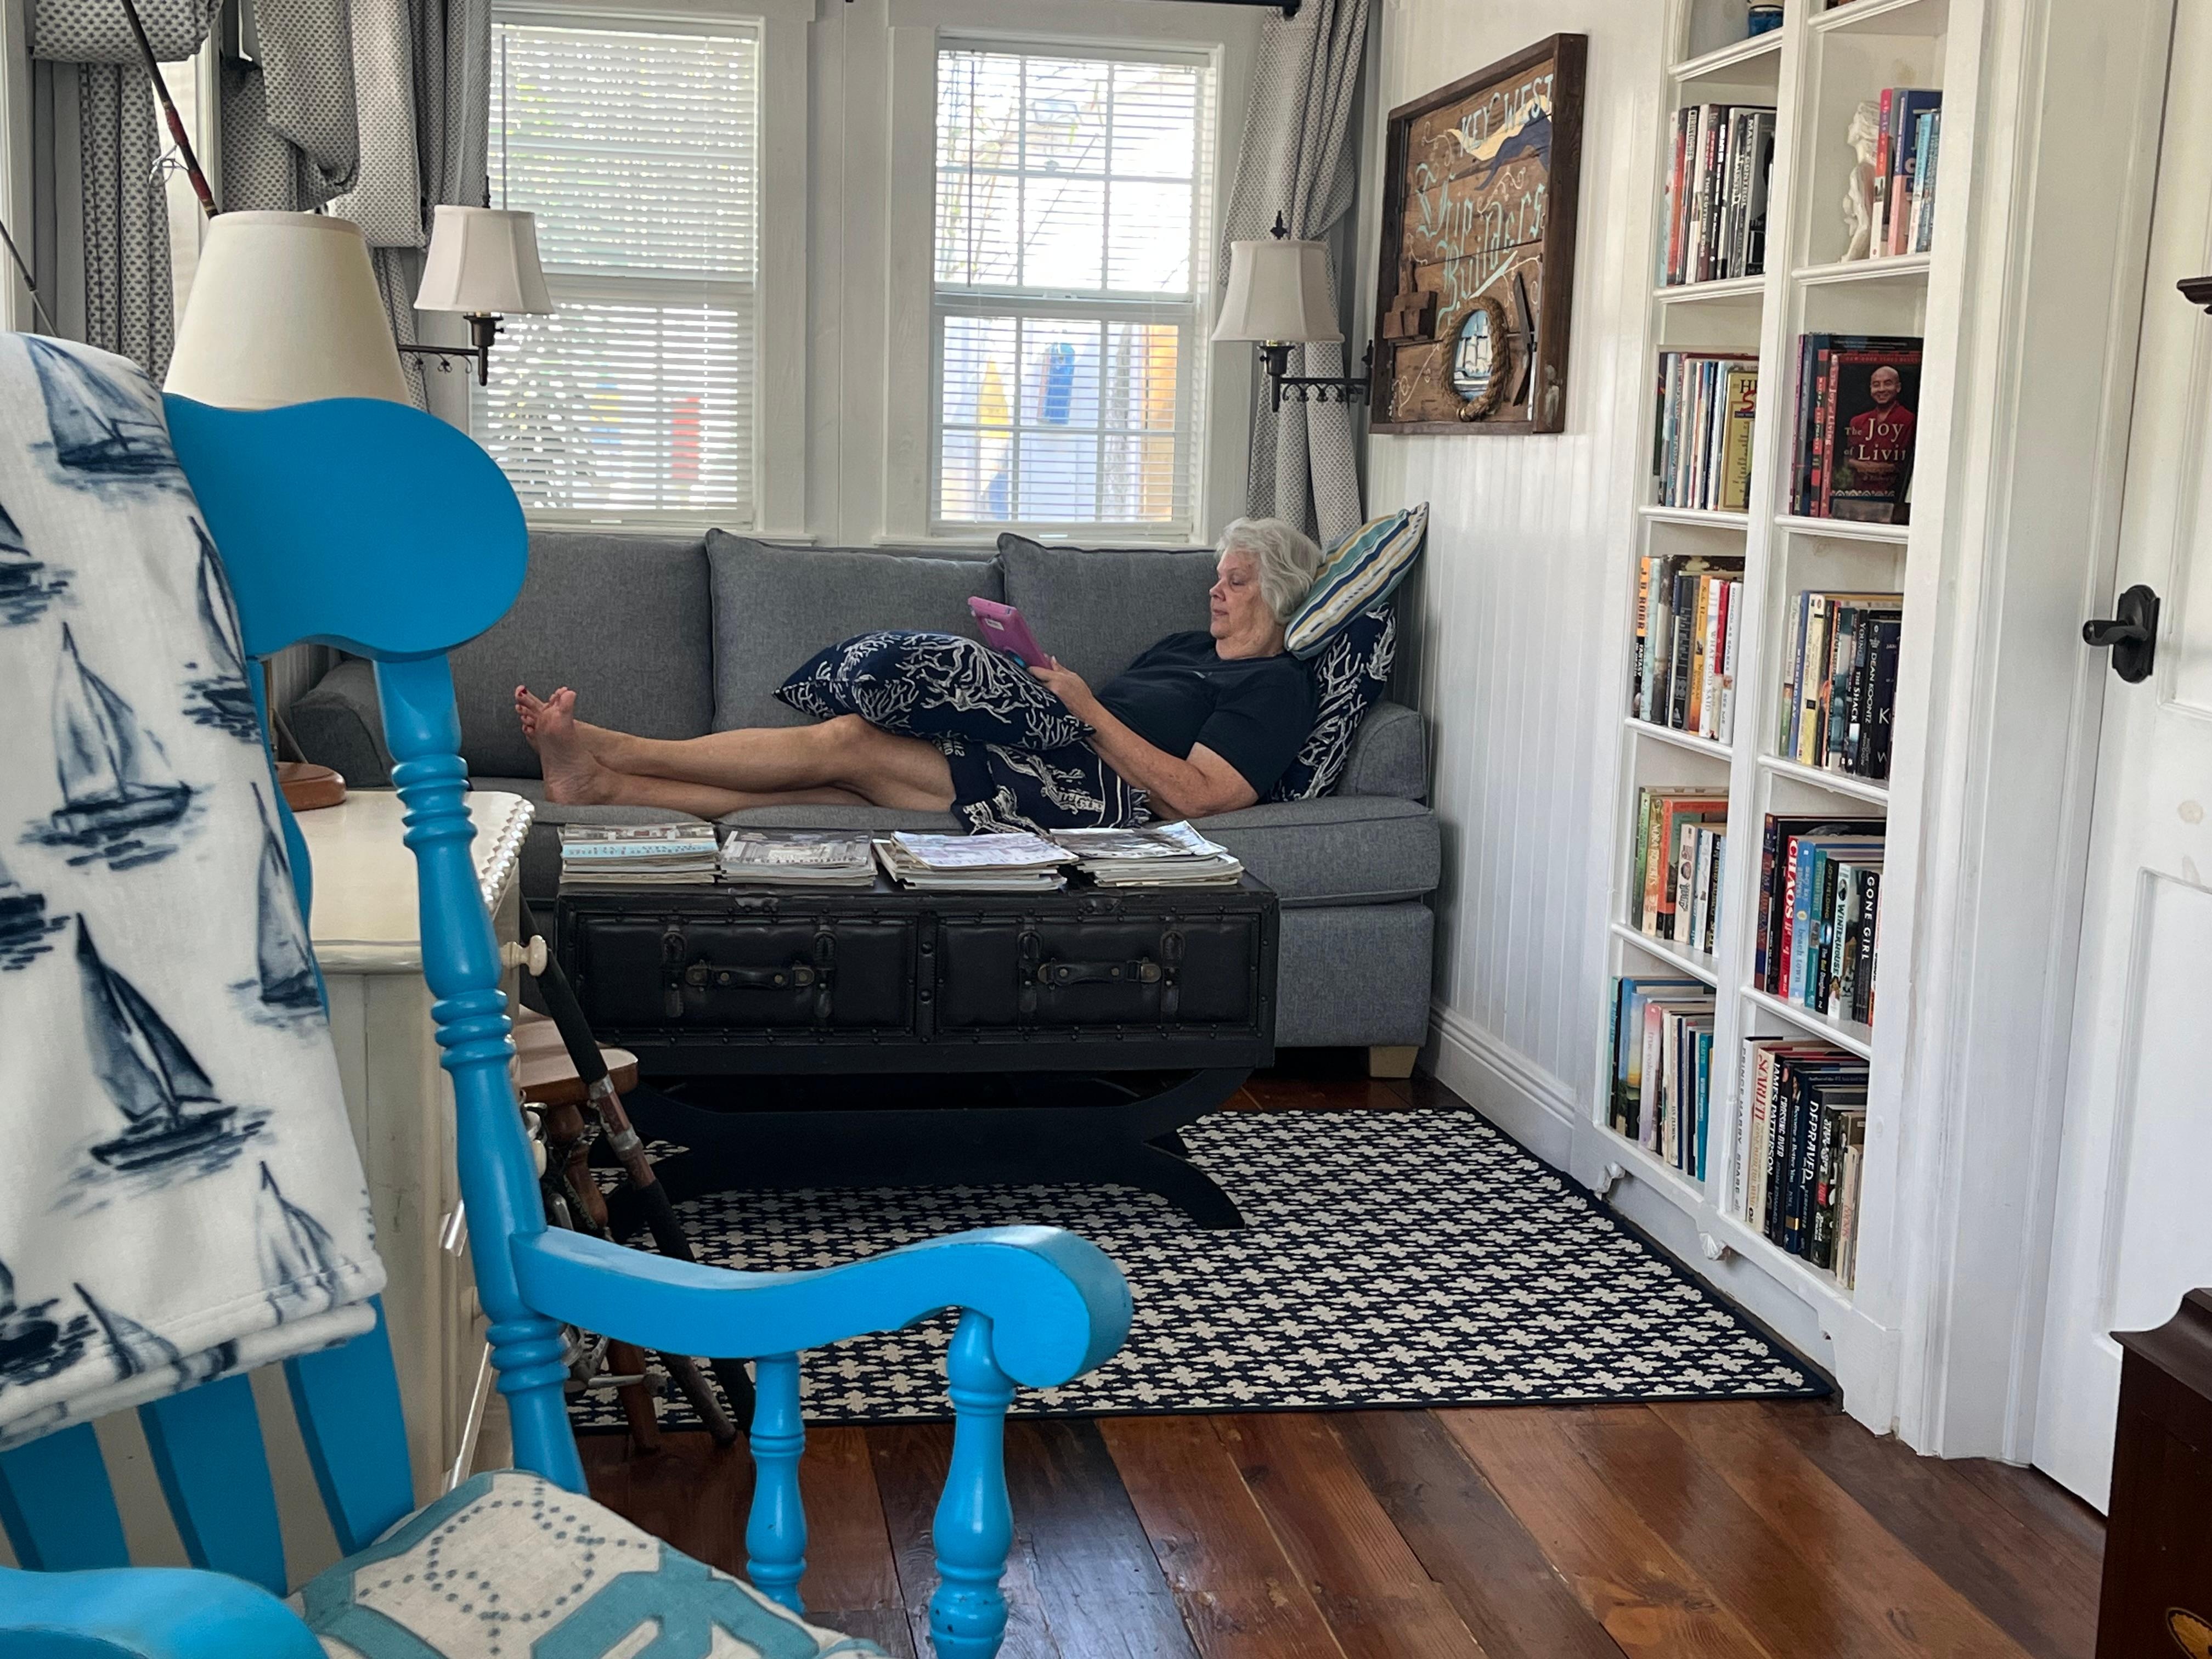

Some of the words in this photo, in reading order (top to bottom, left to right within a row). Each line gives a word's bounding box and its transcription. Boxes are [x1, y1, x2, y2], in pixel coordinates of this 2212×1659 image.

[1459, 92, 1500, 157] KEY
[1504, 74, 1554, 133] WEST
[1740, 156, 1751, 210] CONTROL
[1828, 388, 1837, 404] Joy
[1824, 415, 1836, 446] Living
[1844, 427, 1862, 436] The
[1865, 418, 1904, 443] Joy
[1844, 447, 1855, 456] of
[1637, 596, 1646, 630] ROBB
[1728, 588, 1736, 637] NICHOLAS
[1869, 652, 1877, 681] DEAN
[1705, 689, 1713, 712] SAID
[1850, 687, 1861, 723] SHACK
[1865, 684, 1875, 724] KOONTZ
[1651, 823, 1661, 848] NORA
[1648, 849, 1660, 886] ROBERTS
[1785, 839, 1798, 919] CHAOS
[1824, 882, 1832, 918] FIELDING
[1865, 876, 1876, 921] GONE
[1797, 929, 1805, 956] beach
[1832, 904, 1846, 975] WINTERHOUSE
[1861, 927, 1872, 960] GIRL
[1795, 962, 1804, 983] town
[1646, 1031, 1655, 1050] true
[1754, 1053, 1769, 1121] SCARLETT
[1771, 1062, 1781, 1103] JAMES
[1778, 1094, 1788, 1135] CROSSING
[1792, 1105, 1801, 1136] Become
[1767, 1104, 1778, 1176] PATTERSON
[1776, 1135, 1785, 1158] OVER
[1803, 1101, 1820, 1181] DEPRAVED
